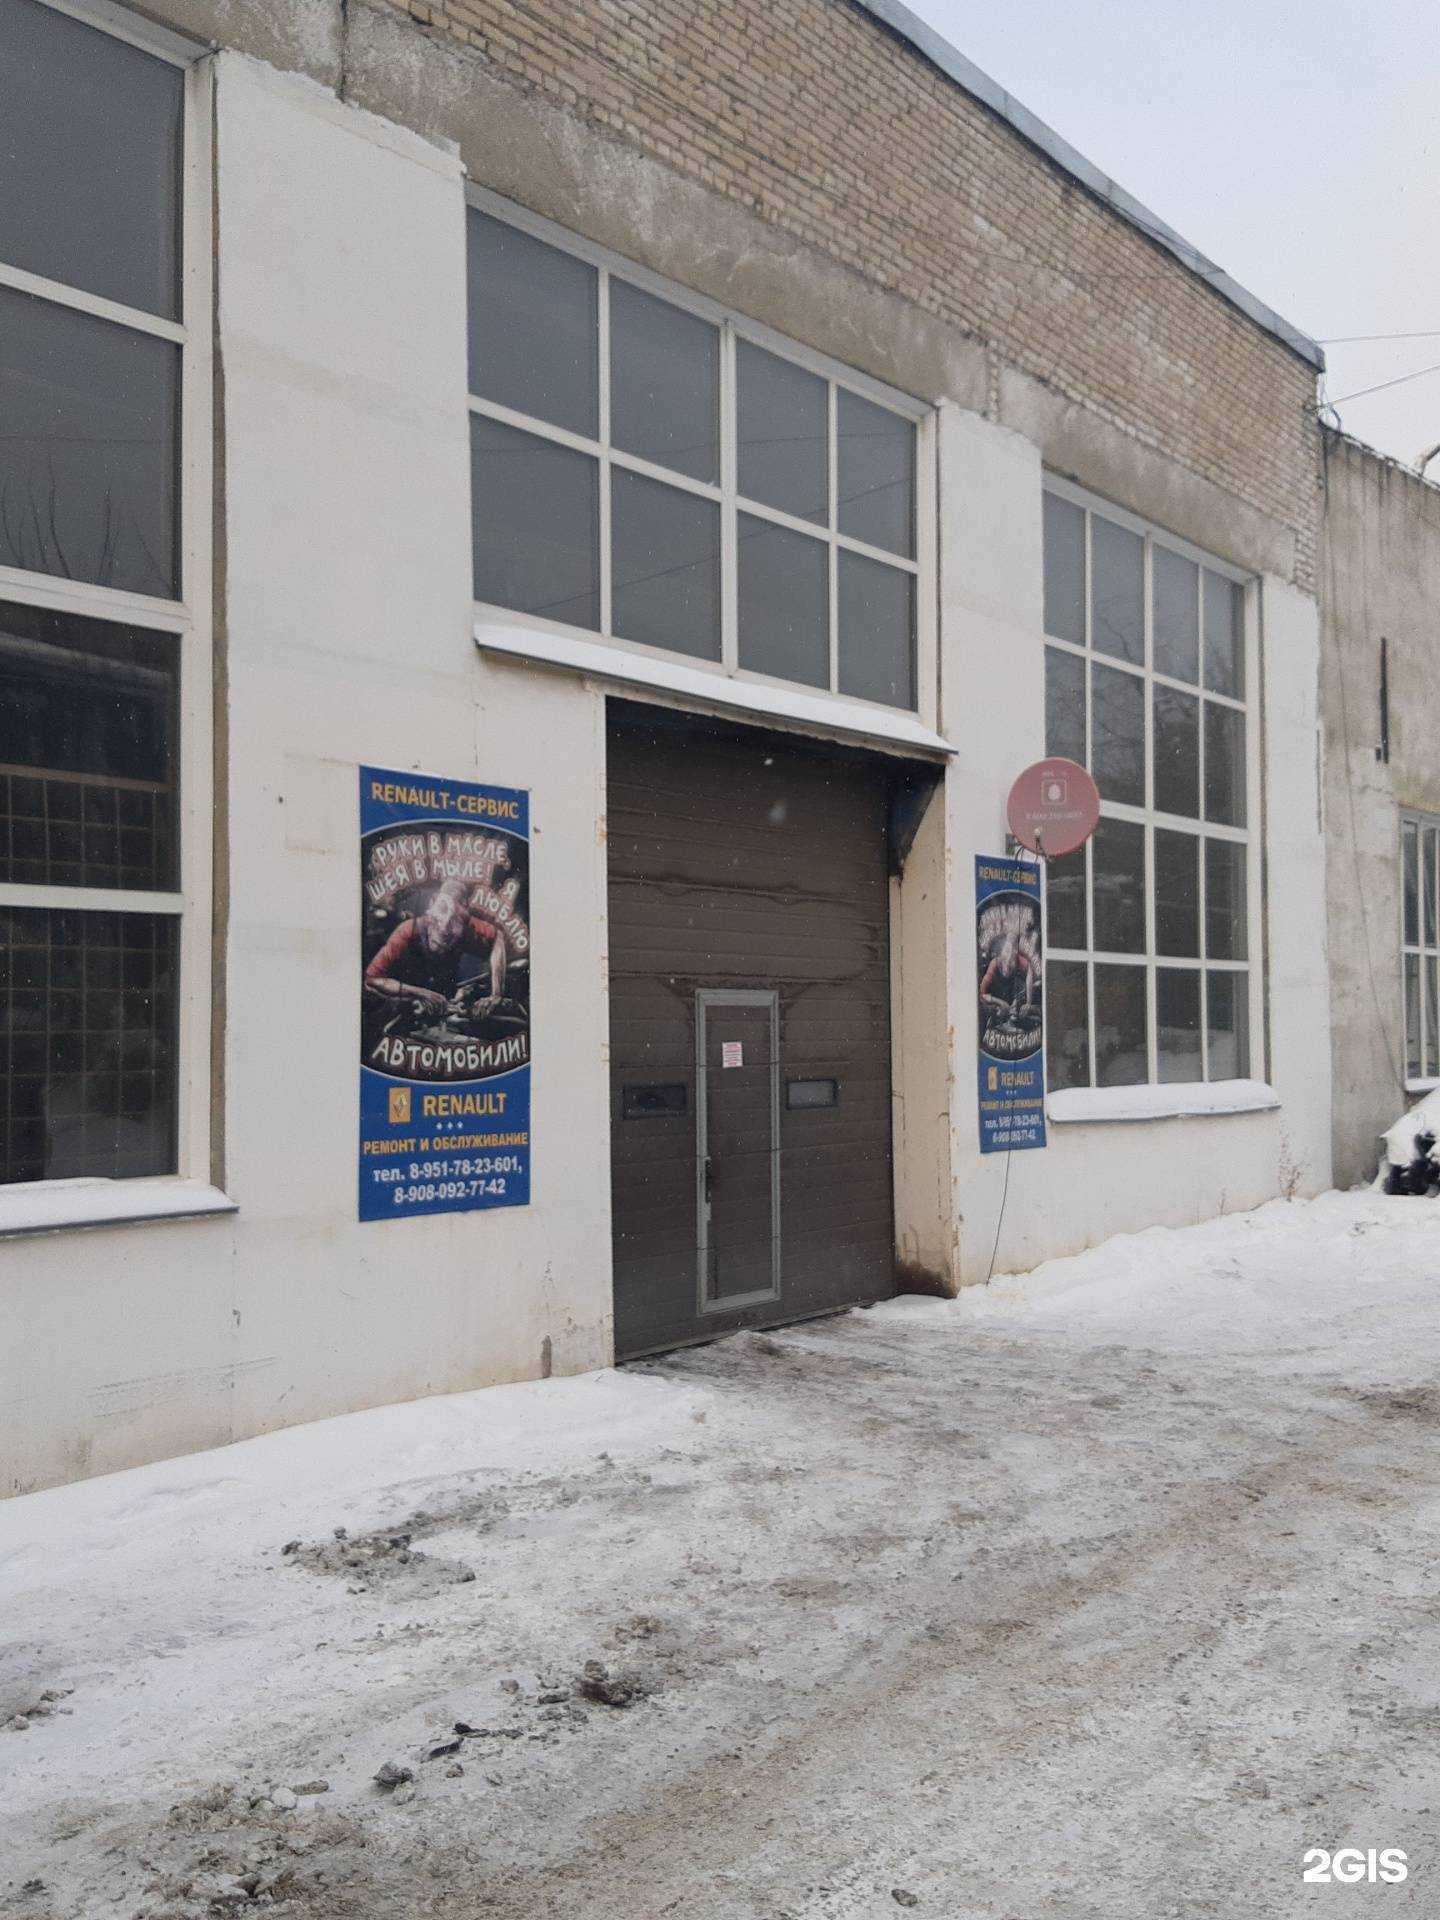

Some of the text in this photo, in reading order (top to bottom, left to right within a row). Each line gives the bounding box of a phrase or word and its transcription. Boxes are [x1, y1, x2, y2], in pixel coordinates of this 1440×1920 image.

[371, 782, 519, 819] RENAULT-СЕРВИС
[376, 838, 424, 866] РУКИ
[429, 834, 440, 855] В
[367, 864, 410, 900] ШЕЯ
[414, 859, 426, 880] В
[979, 865, 1037, 885] RENAULT-СЕ
[505, 881, 517, 900] Я
[472, 888, 528, 949] ЛЮБЛЮ
[372, 1034, 528, 1072] АВТОМОБИЛИ!
[423, 1093, 507, 1116] RENAULT
[363, 1132, 528, 1155] РЕМОНТ И ОБСЛУЖИВАНИЕ
[373, 1155, 523, 1182] тел. 8-951-78-23-601,
[394, 1178, 506, 1203] 8-908-092-77-42
